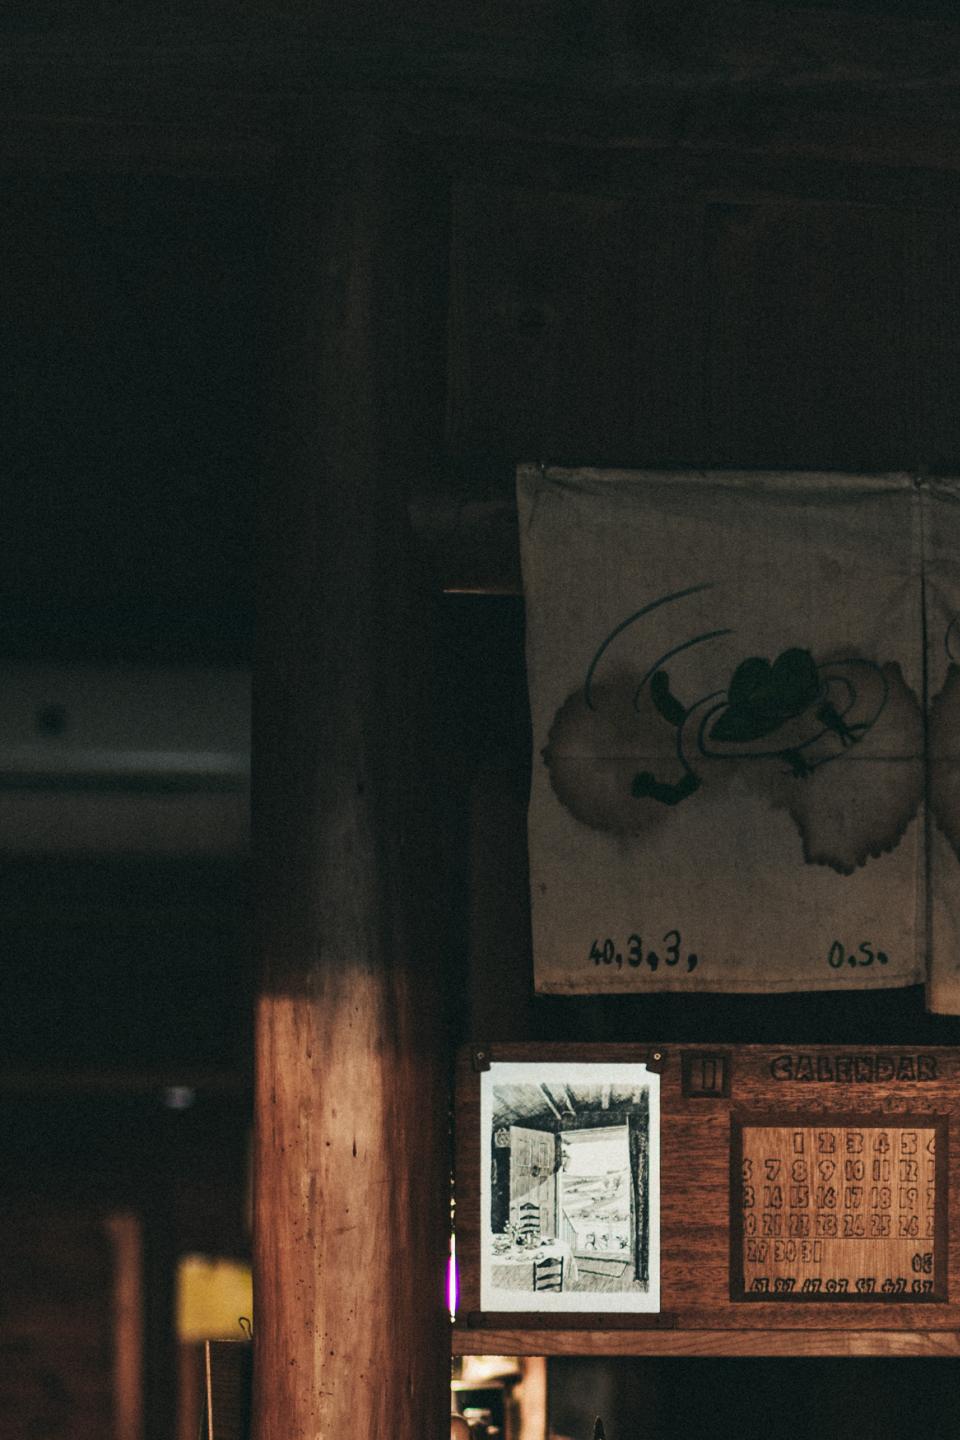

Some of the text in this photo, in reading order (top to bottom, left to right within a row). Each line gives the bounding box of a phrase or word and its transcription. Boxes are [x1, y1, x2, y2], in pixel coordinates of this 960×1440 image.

[770, 1055, 939, 1083] CALENDAR
[793, 1132, 918, 1155] 1 2 3 4 5
[764, 1159, 781, 1181] 7
[791, 1159, 807, 1182] 8
[818, 1159, 836, 1181] 9
[845, 1159, 865, 1181] 10
[872, 1159, 890, 1182] 11
[900, 1159, 918, 1182] 12
[763, 1186, 783, 1209] 14
[790, 1186, 810, 1209] 15
[815, 1186, 837, 1210] 16
[844, 1186, 863, 1209] 17
[871, 1186, 892, 1210] 18
[899, 1186, 919, 1210] 19
[762, 1213, 782, 1236] 21
[789, 1213, 810, 1236] 22
[815, 1213, 837, 1237] 23
[843, 1213, 865, 1237] 24
[870, 1213, 891, 1237] 25
[899, 1214, 919, 1237] 26
